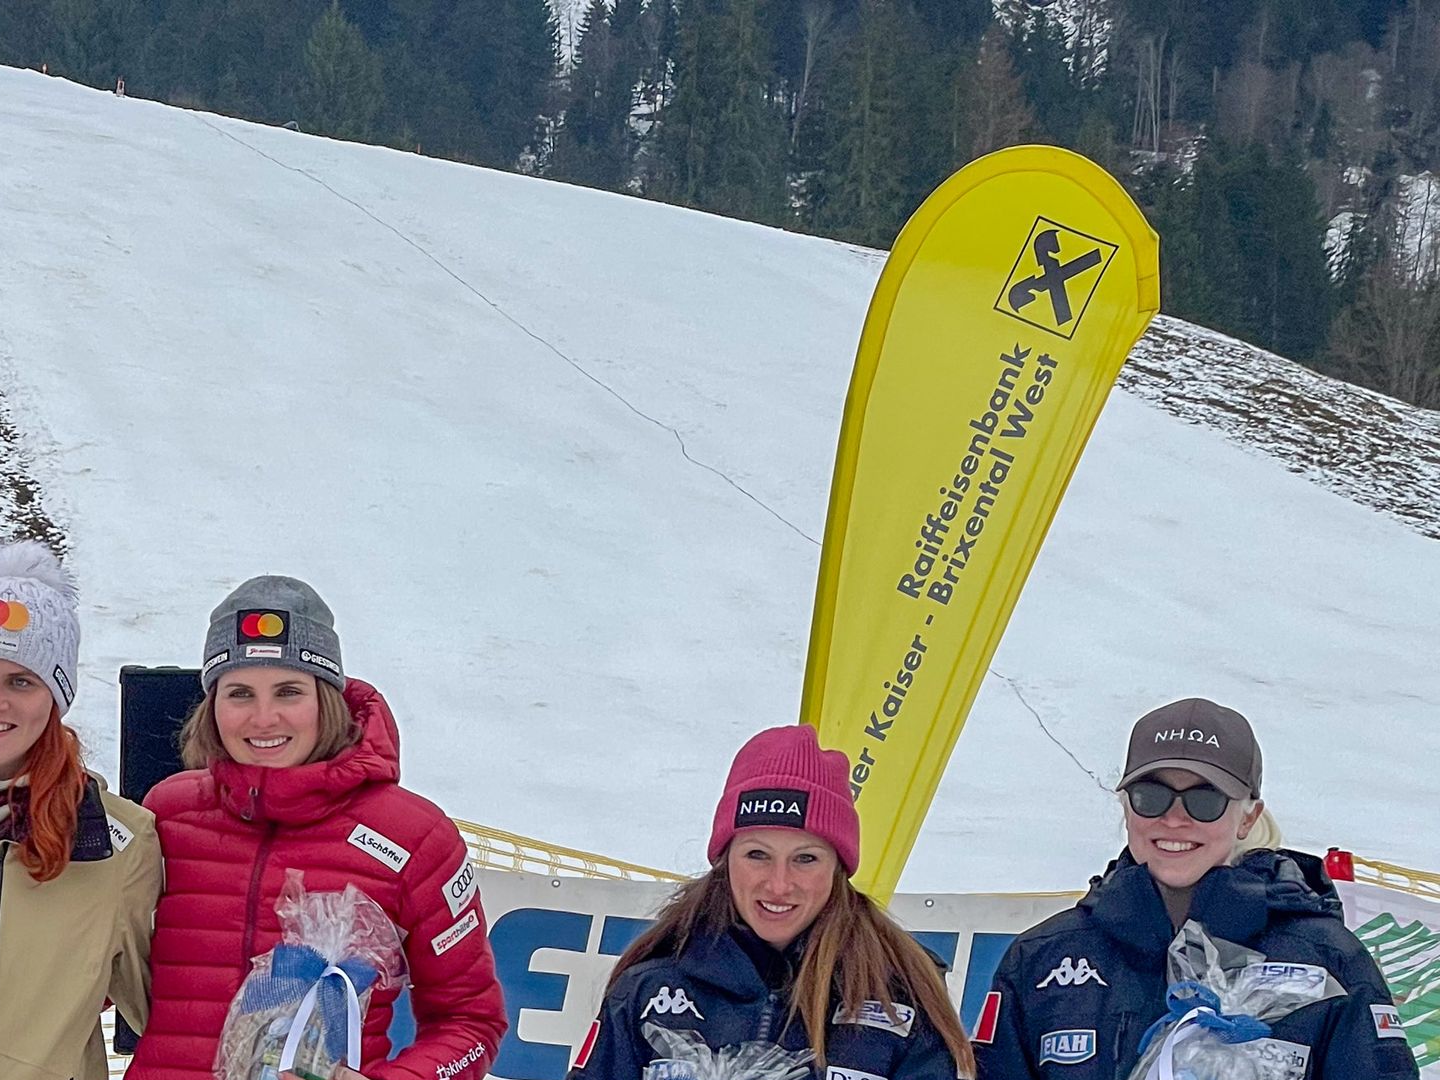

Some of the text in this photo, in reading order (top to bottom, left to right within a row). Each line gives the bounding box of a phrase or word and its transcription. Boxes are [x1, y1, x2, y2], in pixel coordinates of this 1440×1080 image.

[864, 634, 928, 742] Kaiser
[927, 447, 1015, 606] Brixental
[1000, 353, 1058, 438] West
[897, 342, 1032, 599] Raiffeisenbank
[367, 835, 403, 864] Schöffel
